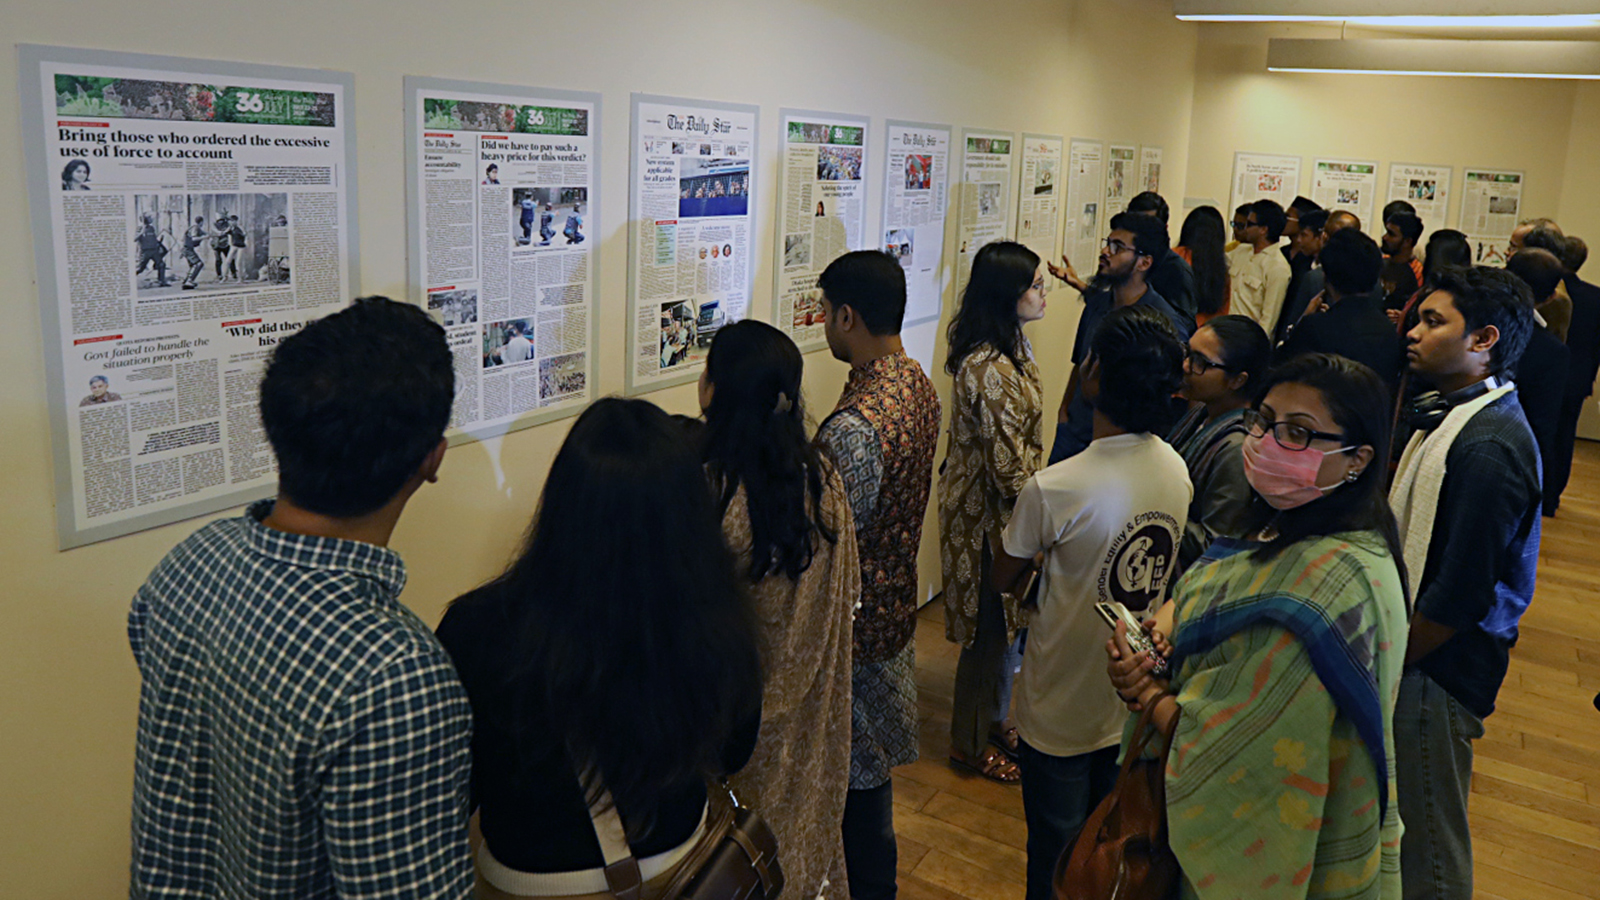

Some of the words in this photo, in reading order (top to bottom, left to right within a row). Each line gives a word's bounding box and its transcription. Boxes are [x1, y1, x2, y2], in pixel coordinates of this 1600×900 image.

[236, 92, 263, 112] 36
[527, 109, 544, 125] 36
[666, 113, 684, 131] The
[686, 115, 710, 135] Daily
[711, 117, 731, 136] Star
[59, 129, 107, 144] Bring
[111, 131, 154, 143] those
[158, 133, 189, 144] who
[193, 134, 246, 146] ordered
[250, 136, 273, 147] the
[274, 137, 331, 149] excessive
[435, 140, 449, 149] Daily
[61, 147, 89, 157] use
[93, 146, 110, 158] of
[113, 146, 153, 158] force
[157, 149, 173, 159] to
[176, 149, 233, 160] account
[481, 140, 497, 150] Did
[511, 141, 529, 151] have
[530, 143, 539, 151] to
[540, 144, 554, 154] pay
[555, 143, 571, 152] such
[481, 151, 505, 162] heavy
[506, 151, 527, 163] price
[528, 152, 541, 161] for
[541, 151, 556, 162] this
[557, 153, 586, 162] verdict?
[647, 166, 673, 175] applicable
[659, 175, 676, 183] grades
[258, 323, 277, 334] did
[280, 320, 302, 332] they
[258, 336, 277, 347] his
[84, 351, 109, 362] Govt
[110, 345, 142, 361] failed
[157, 340, 191, 351] handle
[194, 337, 210, 347] the
[103, 356, 151, 370] situation
[152, 350, 195, 365] properly
[1104, 530, 1127, 564] Equity
[1126, 522, 1134, 532] &
